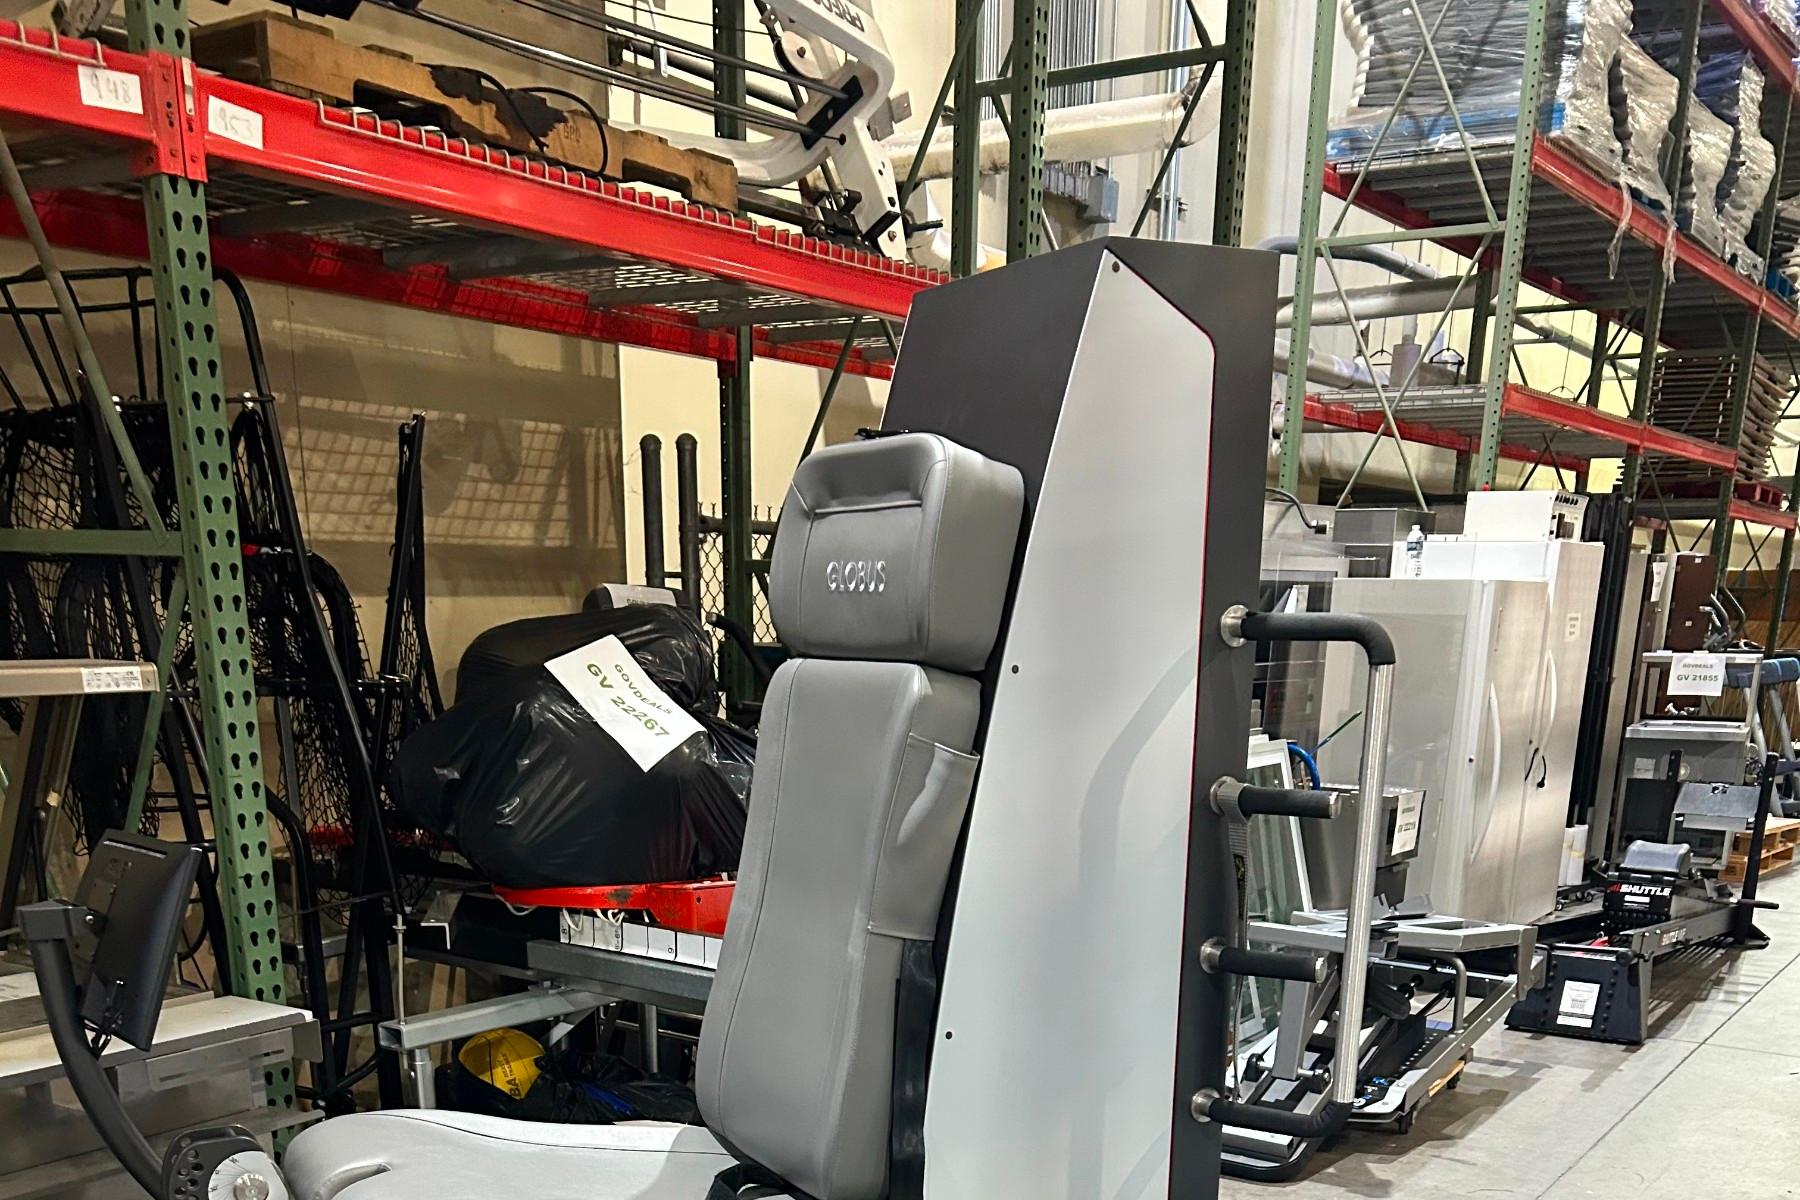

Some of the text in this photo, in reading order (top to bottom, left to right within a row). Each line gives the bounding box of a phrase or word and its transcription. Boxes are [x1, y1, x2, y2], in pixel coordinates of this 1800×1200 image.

[826, 560, 886, 592] GLOBUS
[586, 663, 671, 737] GV 22267
[613, 663, 673, 715] GOVDEALS
[1619, 884, 1672, 896] SHUTTLE
